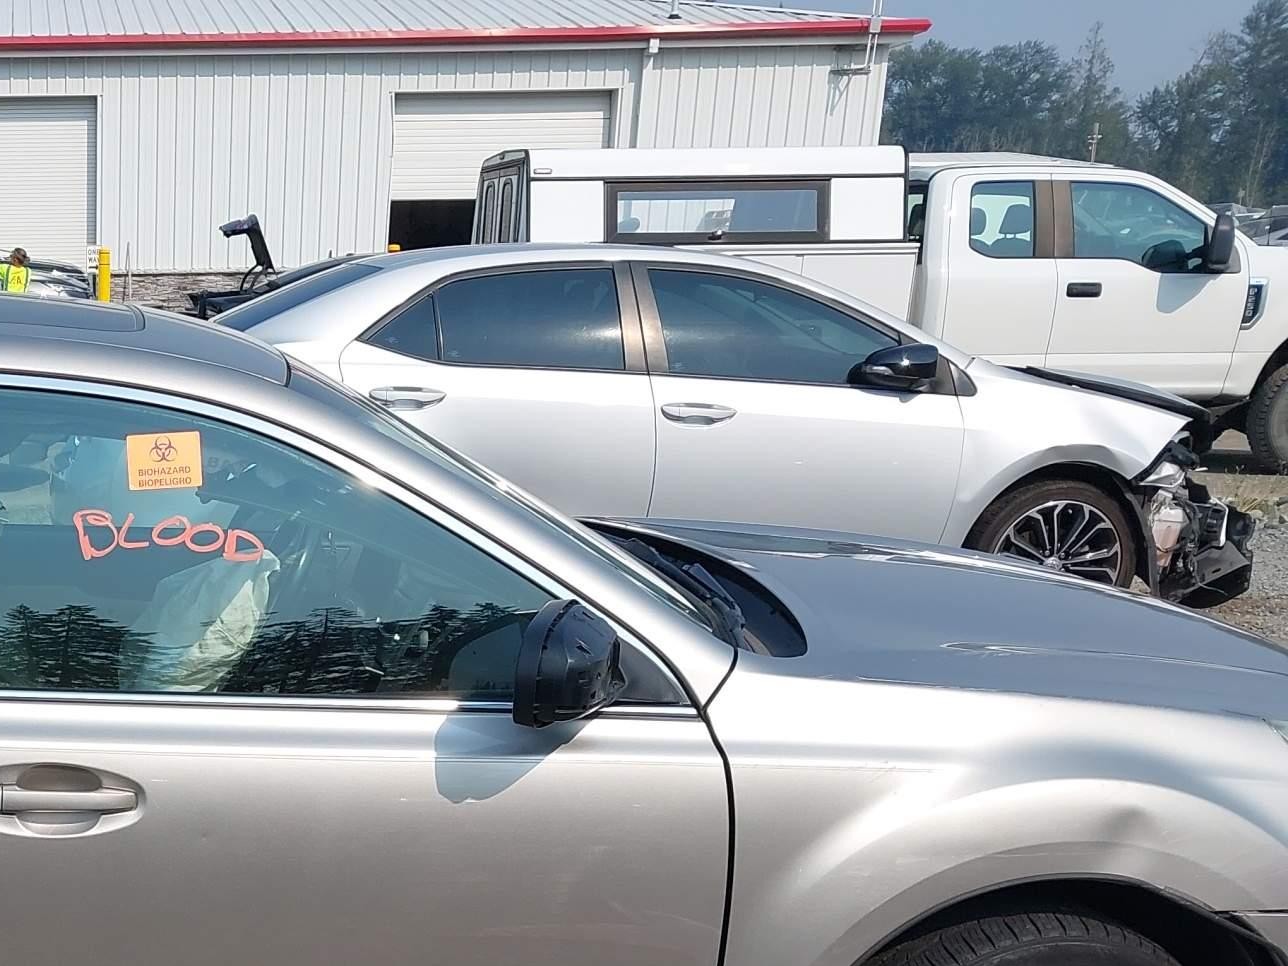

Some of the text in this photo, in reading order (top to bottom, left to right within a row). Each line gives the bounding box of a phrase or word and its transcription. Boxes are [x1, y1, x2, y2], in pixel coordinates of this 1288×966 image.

[138, 466, 191, 477] BIOHAZARD
[138, 476, 192, 488] BIOPELIGRO
[73, 509, 265, 561] BLOOD
